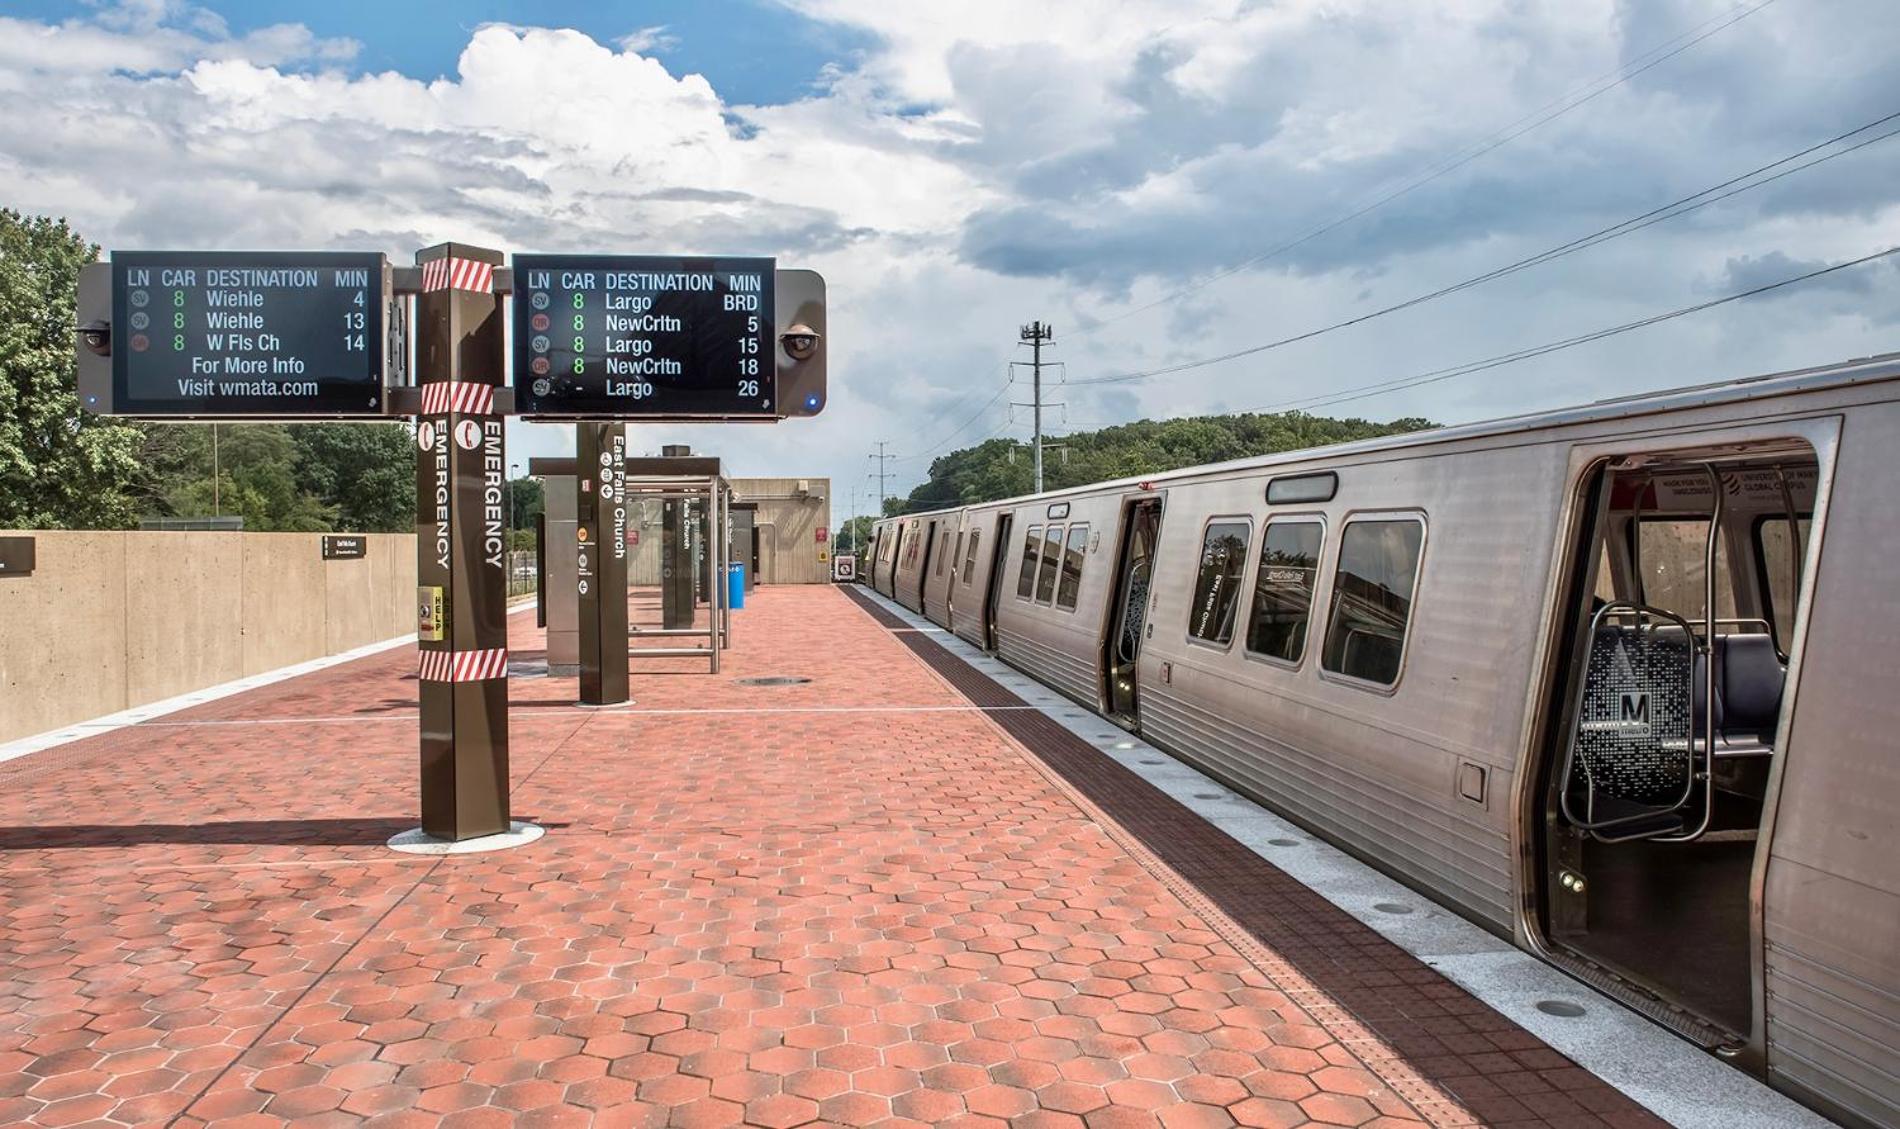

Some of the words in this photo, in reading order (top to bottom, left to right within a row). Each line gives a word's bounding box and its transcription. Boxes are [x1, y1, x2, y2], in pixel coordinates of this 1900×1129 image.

[127, 269, 150, 287] LN
[161, 269, 196, 287] CAR
[206, 269, 318, 288] DESTINATION
[335, 270, 368, 288] MIN
[528, 271, 550, 290] LN
[561, 272, 596, 290] CAR
[605, 272, 713, 291] DESTINATION
[729, 274, 761, 292] MIN
[173, 290, 185, 308] 8
[206, 289, 264, 308] Wiehle
[353, 290, 365, 308] 4
[573, 292, 585, 310] 8
[605, 292, 652, 314] Largo
[724, 294, 758, 311] BRD
[173, 312, 185, 329] 8
[206, 311, 264, 329] Wiehle
[344, 312, 365, 330] 13
[573, 314, 585, 331] 8
[605, 313, 681, 332] NewCrltn
[747, 315, 759, 333] 5
[173, 333, 185, 351] 8
[206, 333, 224, 351] W
[228, 333, 253, 351] Fls
[258, 333, 280, 351] Ch
[344, 334, 365, 351] 14
[573, 335, 585, 353] 8
[605, 335, 652, 357] Largo
[738, 337, 759, 354] 15
[192, 356, 220, 374] For
[224, 356, 268, 374] More
[272, 356, 305, 374] Info
[573, 356, 585, 375] 8
[606, 357, 681, 375] NewCrltn
[738, 358, 759, 376] 18
[177, 378, 215, 396] Visit
[218, 378, 318, 396] wmata.com
[606, 378, 653, 400] Largo
[738, 379, 759, 397] 26
[613, 435, 625, 467] East
[435, 419, 449, 570] EMERGENCY
[484, 421, 503, 569] EMERGENCY
[614, 470, 625, 504] Falls
[614, 507, 626, 559] Church
[1621, 694, 1650, 724] M
